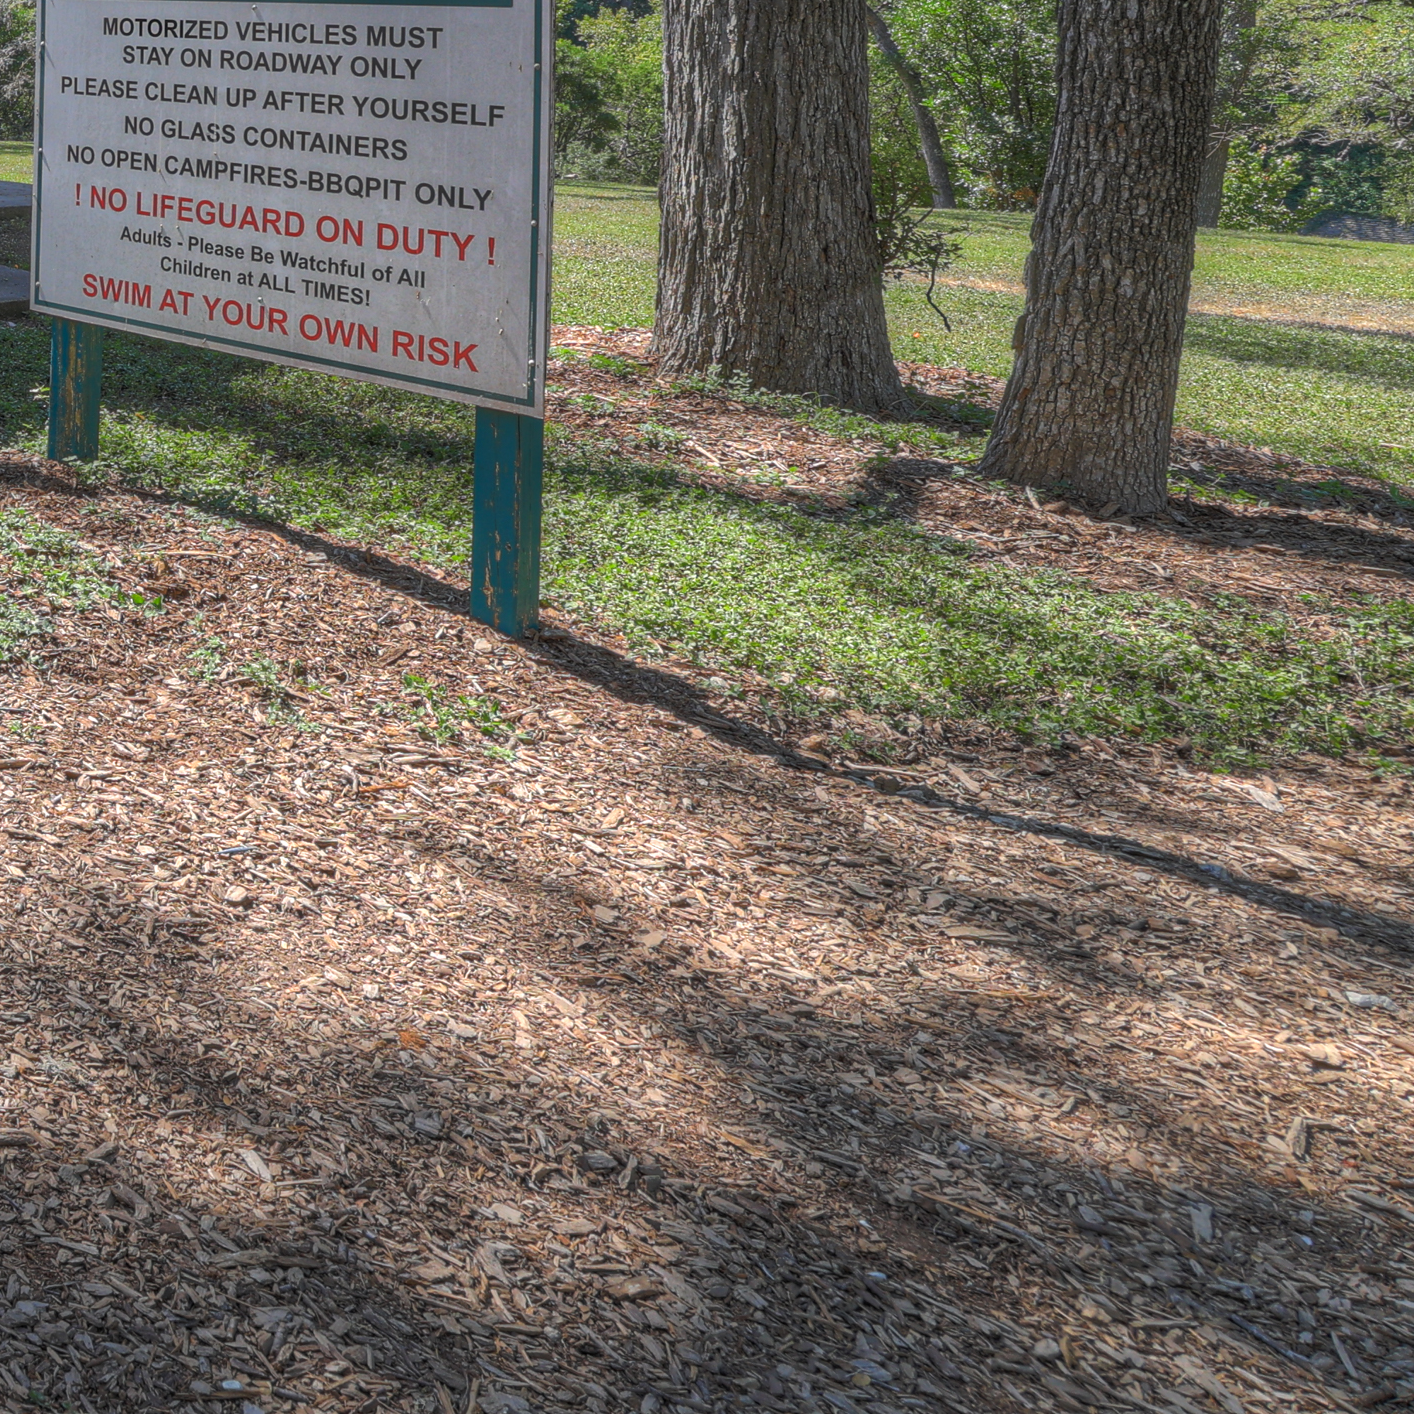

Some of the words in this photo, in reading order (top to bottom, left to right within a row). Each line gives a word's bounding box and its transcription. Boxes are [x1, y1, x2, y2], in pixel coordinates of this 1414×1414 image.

[104, 18, 229, 39] MOTORIZED
[236, 22, 358, 45] VEHICLES
[367, 26, 444, 48] MUST
[123, 45, 175, 65] STAY
[181, 48, 212, 68] ON
[220, 50, 343, 75] ROADWAY
[351, 56, 423, 80] ONLY
[62, 76, 139, 99] PLEASE
[145, 82, 218, 105] CLEAN
[227, 88, 257, 107] UP
[263, 90, 345, 115] AFTER
[352, 96, 506, 127] YOURSELF
[125, 116, 155, 136] NO
[161, 119, 236, 144] GLASS
[244, 127, 408, 161] CONTAINERS
[68, 145, 95, 164] NO
[101, 149, 158, 172] OPEN
[165, 156, 407, 201] CAMPFIRES-BBQPIT
[415, 183, 492, 211] ONLY
[91, 186, 128, 212] NO
[137, 192, 305, 237] LIFEGUARD
[316, 216, 364, 246] ON
[377, 223, 475, 261] DUTY
[120, 224, 172, 248] Adults
[188, 236, 245, 263] Please
[251, 246, 275, 264] Be
[280, 250, 365, 278] Watchful
[372, 266, 393, 282] of
[397, 269, 426, 288] All
[161, 256, 231, 282] Children
[237, 271, 254, 286] at
[258, 273, 296, 293] ALL
[302, 279, 371, 306] TIMES!
[83, 274, 152, 308] SWIM
[159, 289, 195, 316] AT
[203, 295, 289, 336] YOUR
[300, 314, 379, 353] OWN
[392, 330, 479, 372] RISK
